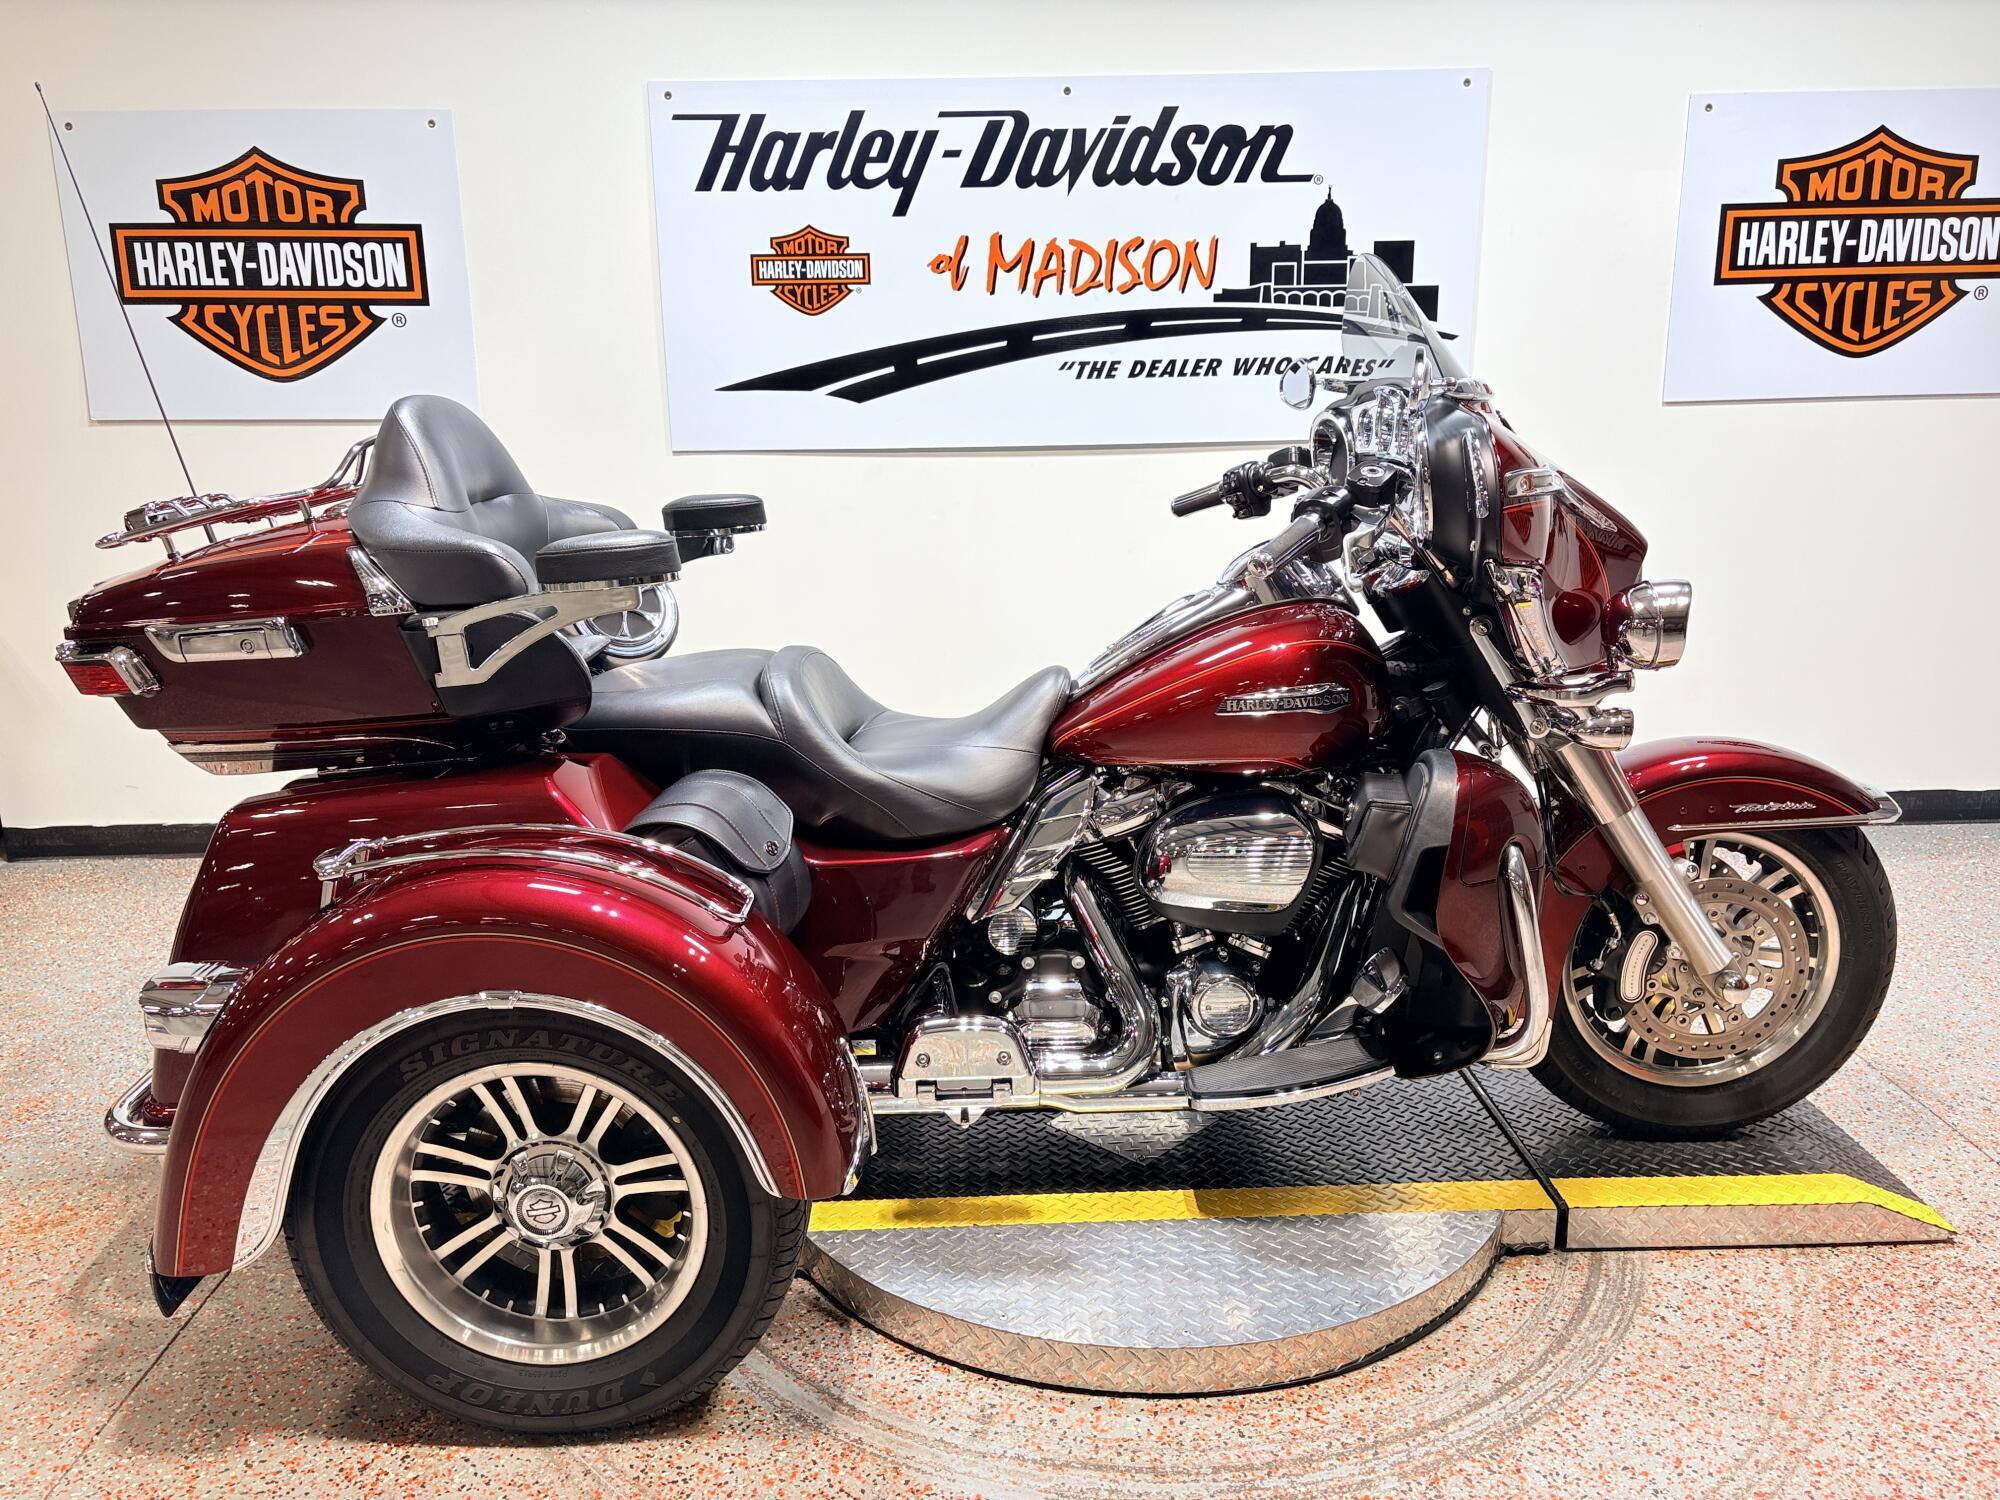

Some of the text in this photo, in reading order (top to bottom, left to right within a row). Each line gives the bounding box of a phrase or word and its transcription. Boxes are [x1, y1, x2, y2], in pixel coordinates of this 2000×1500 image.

[671, 106, 1314, 216] Harley-Davidson
[1807, 148, 1946, 201] MOTOR
[191, 169, 335, 223] MOTOR
[133, 242, 408, 287] HARLEY-DAVIDSON
[782, 233, 838, 254] MOTOR
[986, 231, 1218, 298] MADISON
[1736, 216, 2000, 266] HARLEY-DAVIDSON
[758, 259, 864, 279] HARLEY-DAVIDSON
[783, 285, 839, 310] CYCLES
[1795, 279, 1933, 341] CYCLES
[204, 304, 346, 365] CYCLES
[1127, 358, 1223, 378] DEALER
[1232, 356, 1293, 377] WHO
[1225, 692, 1350, 712] HARLEY-DAVIDSON
[400, 1028, 689, 1101] SIGNATURE
[424, 1373, 624, 1416] DUNLOP
